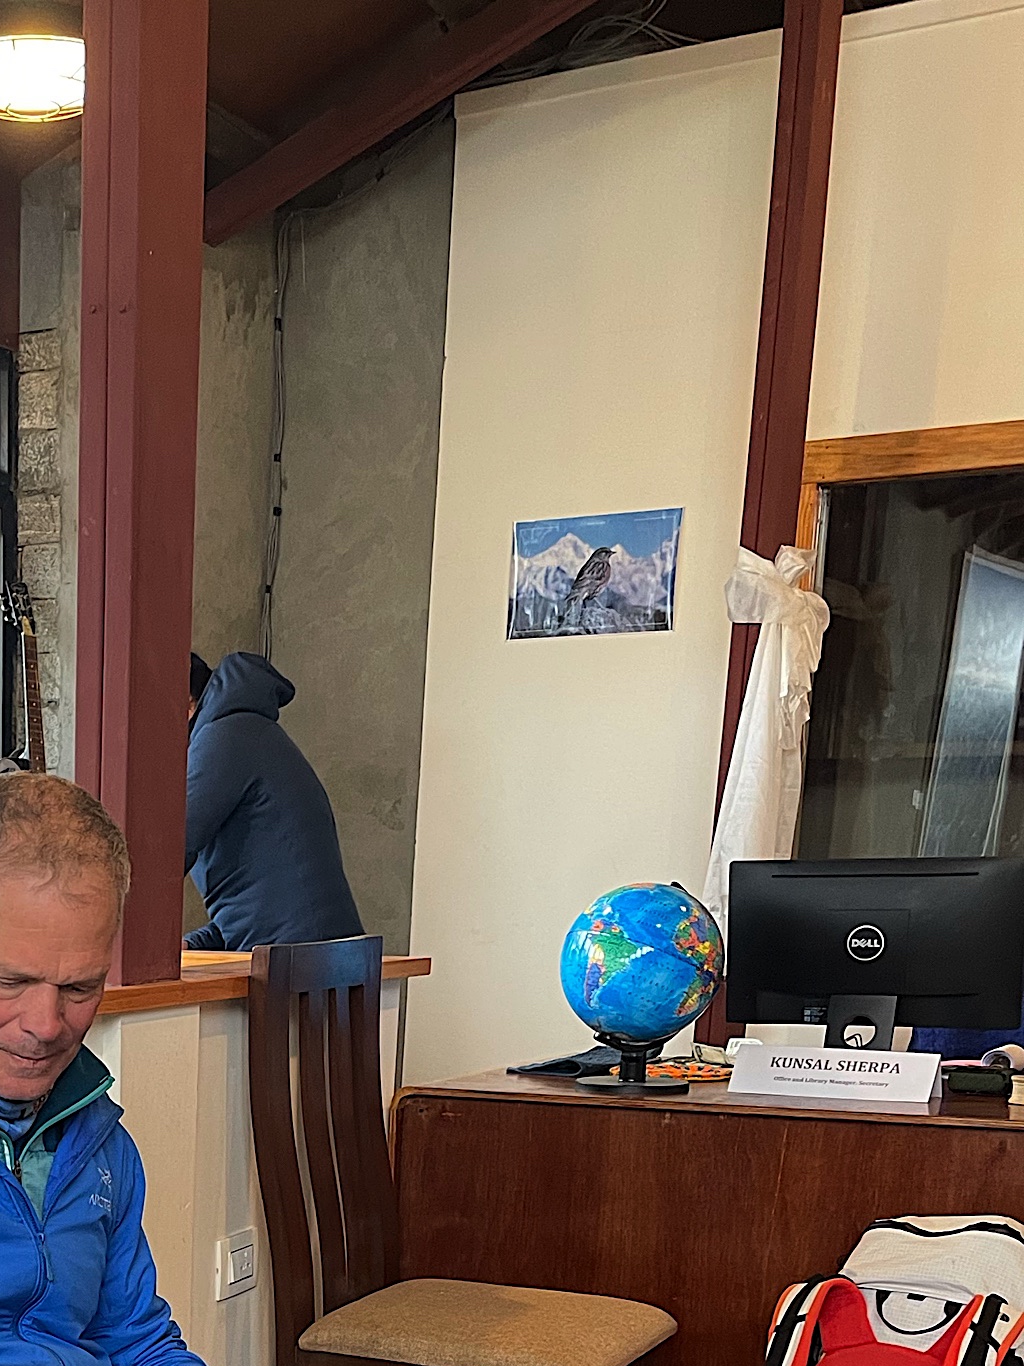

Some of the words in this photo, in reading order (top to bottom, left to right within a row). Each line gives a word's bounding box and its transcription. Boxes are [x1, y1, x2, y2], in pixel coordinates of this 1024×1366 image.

[851, 938, 881, 948] DELL
[770, 1056, 833, 1070] KUNSAL
[836, 1060, 901, 1074] SHERPA
[858, 1080, 889, 1088] Secretary
